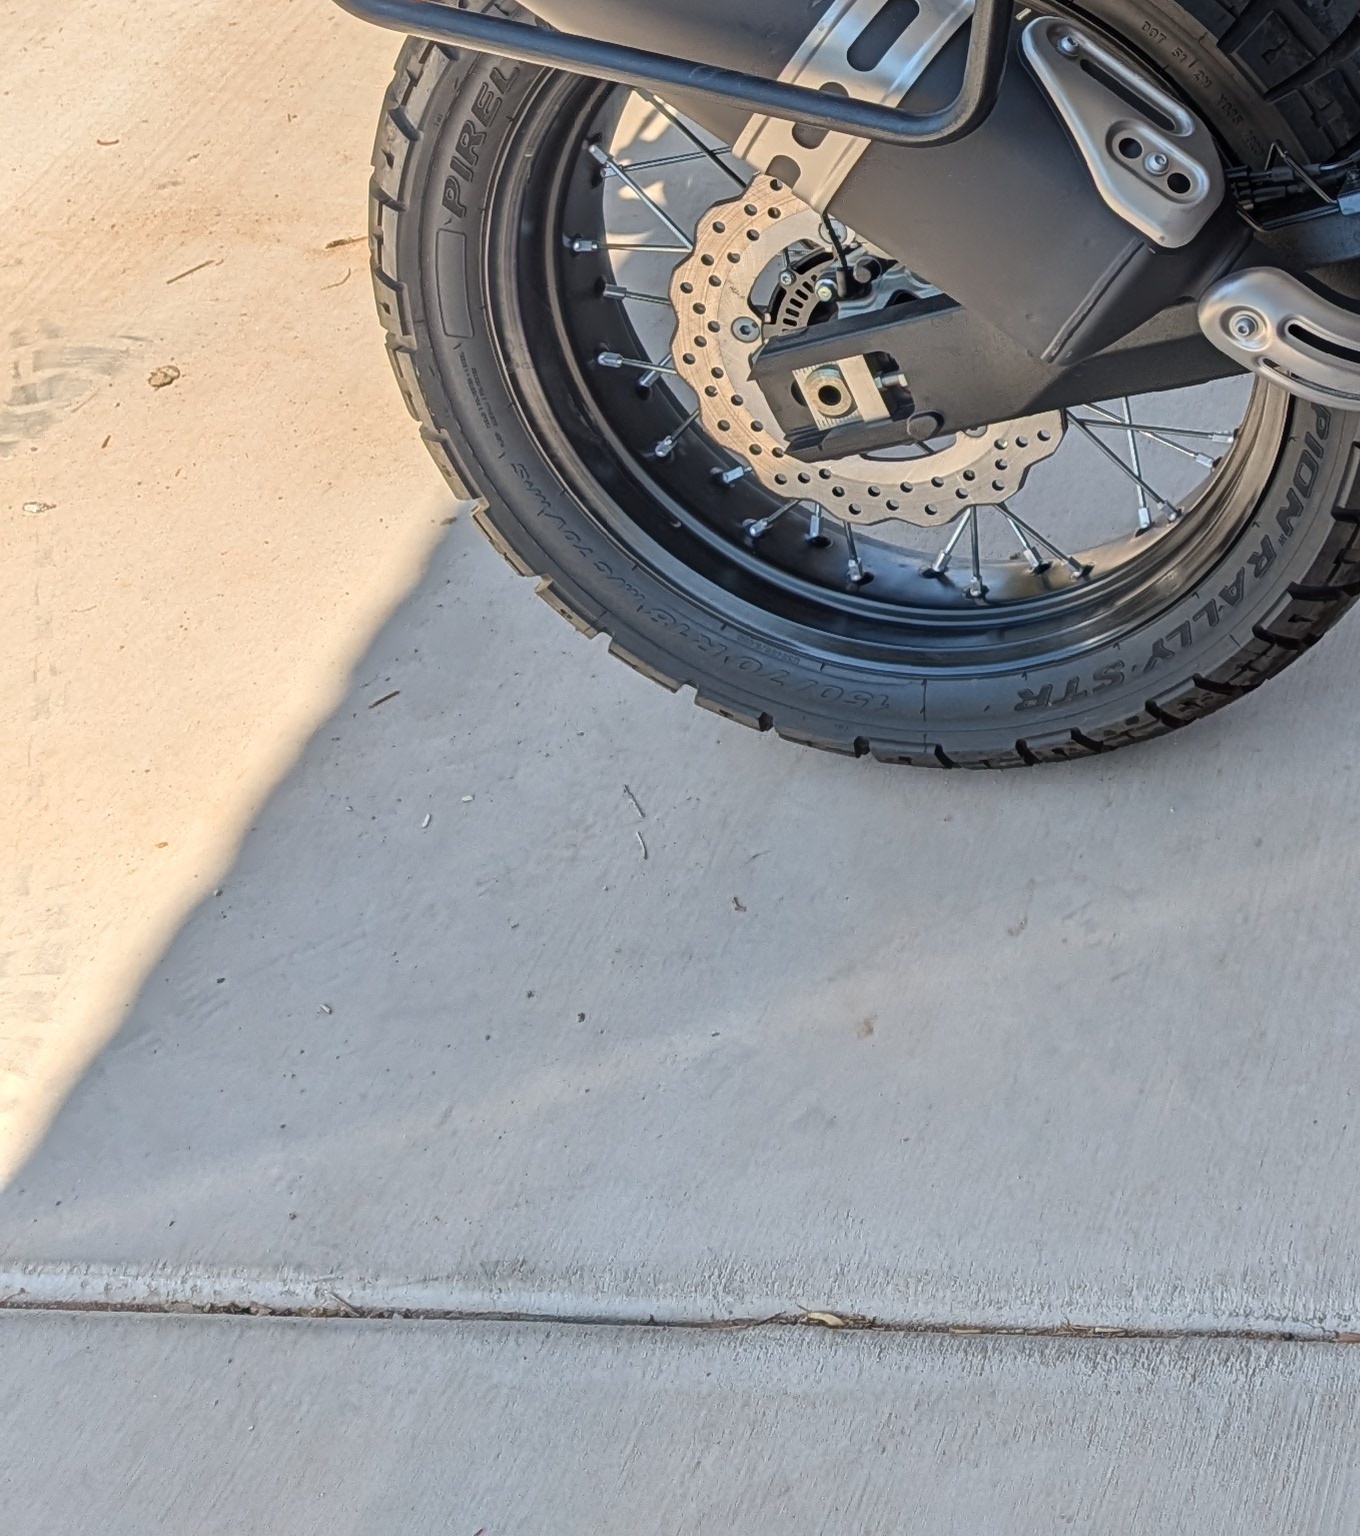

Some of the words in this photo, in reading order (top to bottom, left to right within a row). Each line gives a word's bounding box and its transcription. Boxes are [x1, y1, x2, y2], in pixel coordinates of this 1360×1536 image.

[1141, 20, 1167, 45] DOT
[1142, 534, 1277, 674] RALLY
[1013, 659, 1127, 712] STR
